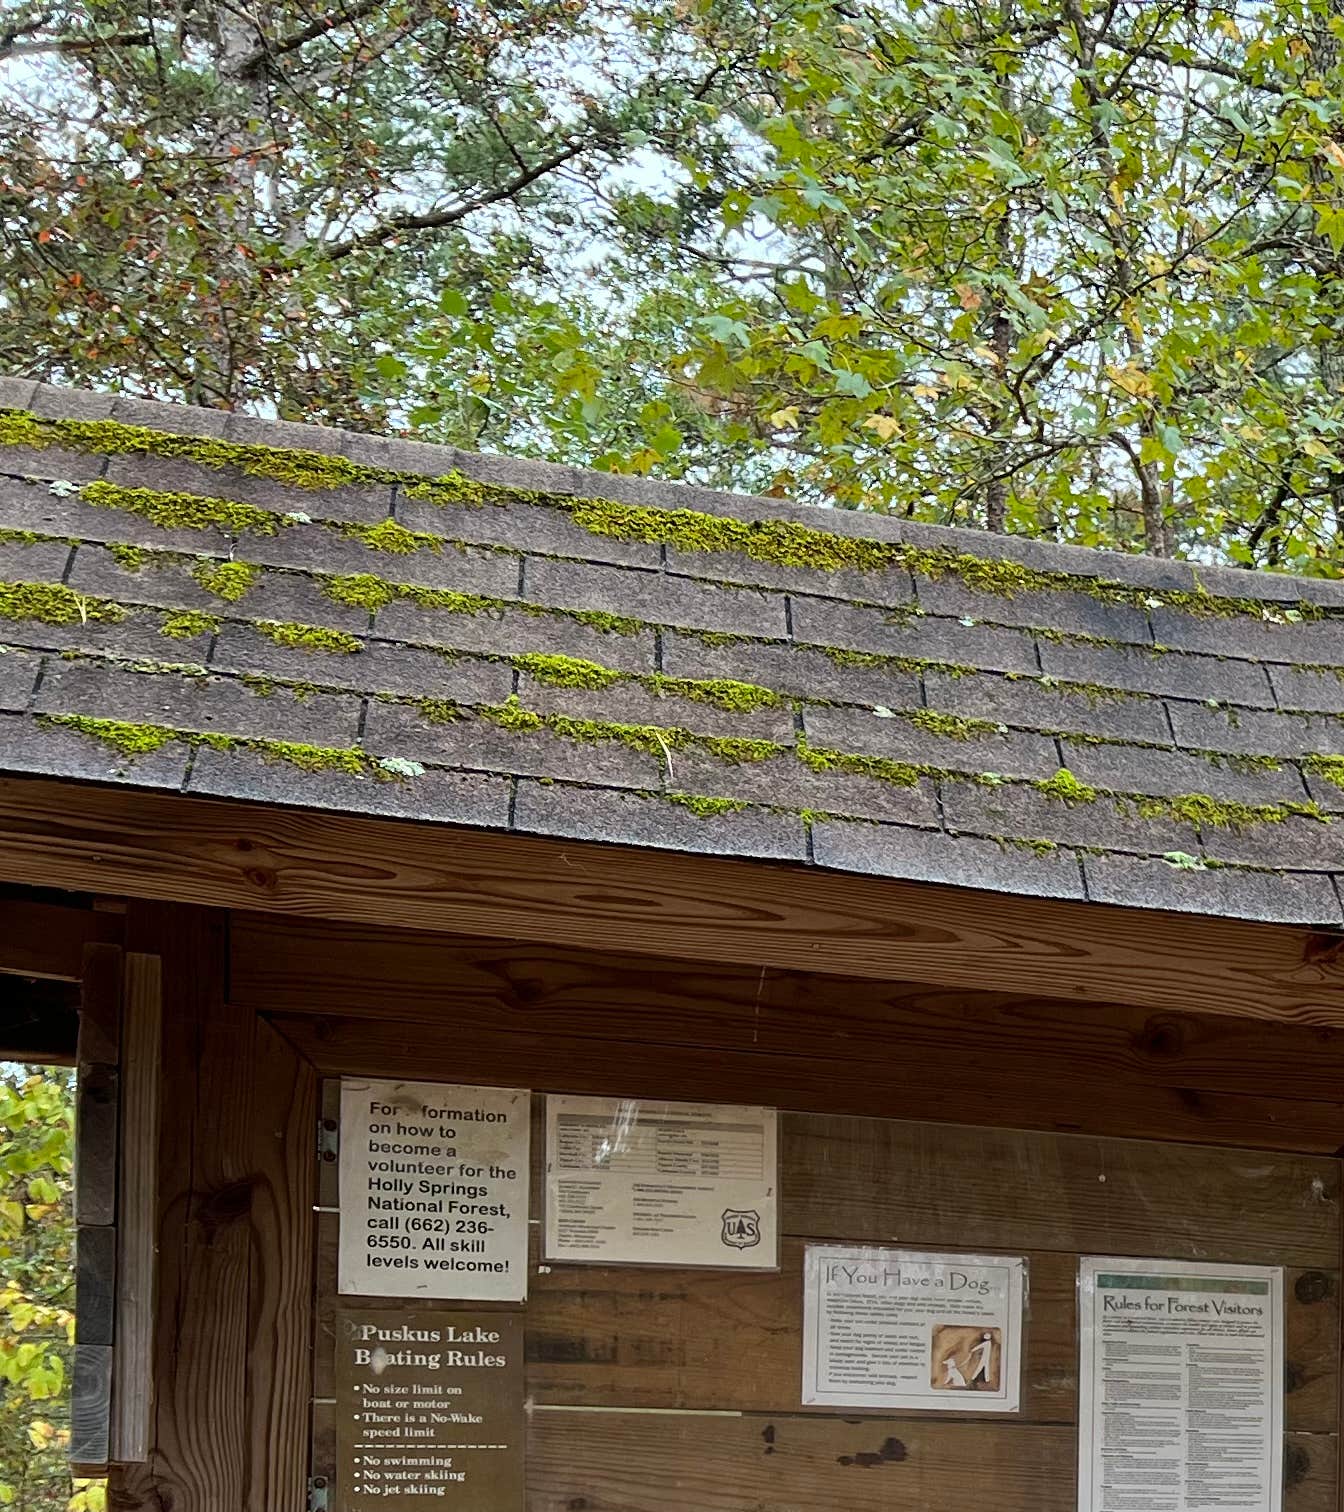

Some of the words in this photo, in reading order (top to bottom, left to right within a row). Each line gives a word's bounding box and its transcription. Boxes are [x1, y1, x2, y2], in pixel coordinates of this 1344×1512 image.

[370, 1102, 400, 1116] For
[369, 1123, 391, 1134] on
[396, 1123, 434, 1137] how
[439, 1125, 457, 1138] to
[369, 1139, 441, 1157] become
[446, 1146, 457, 1157] a
[368, 1159, 455, 1176] volunteer
[459, 1164, 484, 1177] for
[489, 1165, 517, 1179] the
[368, 1177, 413, 1195] Holly
[418, 1180, 488, 1199] Springs
[368, 1196, 443, 1213] National
[448, 1200, 511, 1218] Forest,
[367, 1216, 399, 1229] call
[404, 1217, 450, 1235] (662)
[455, 1220, 495, 1234] 236-
[367, 1235, 417, 1250] 6550.
[422, 1237, 445, 1251] All
[450, 1239, 485, 1253] skill
[367, 1254, 419, 1269] levels
[424, 1258, 509, 1273] welcome!
[825, 1263, 844, 1285] If
[842, 1267, 878, 1285] You
[883, 1268, 930, 1288] Have
[933, 1277, 944, 1289] a
[1103, 1294, 1141, 1312] Rules
[1144, 1295, 1164, 1311] for
[1167, 1297, 1210, 1314] Forest
[1211, 1300, 1263, 1316] Visitors
[362, 1325, 441, 1343] Puskus
[447, 1327, 500, 1343] Lake
[354, 1349, 441, 1369] Bating
[446, 1350, 506, 1367] Rules
[362, 1384, 380, 1394] No
[383, 1384, 409, 1394] size
[412, 1384, 443, 1394] limit
[446, 1386, 462, 1394] on
[363, 1398, 391, 1409] boat
[395, 1400, 409, 1409] or
[413, 1400, 451, 1409] motor
[362, 1413, 401, 1423] There
[404, 1413, 416, 1423] is
[430, 1413, 483, 1424] No-Wake
[362, 1427, 401, 1439] speed
[404, 1427, 435, 1437] limit
[362, 1456, 380, 1466] No
[383, 1456, 452, 1468] swimming
[362, 1470, 380, 1480] No
[383, 1471, 421, 1480] water
[424, 1470, 466, 1481] skiing
[362, 1484, 381, 1495] No
[383, 1484, 401, 1496] jet
[404, 1485, 446, 1496] skiing
